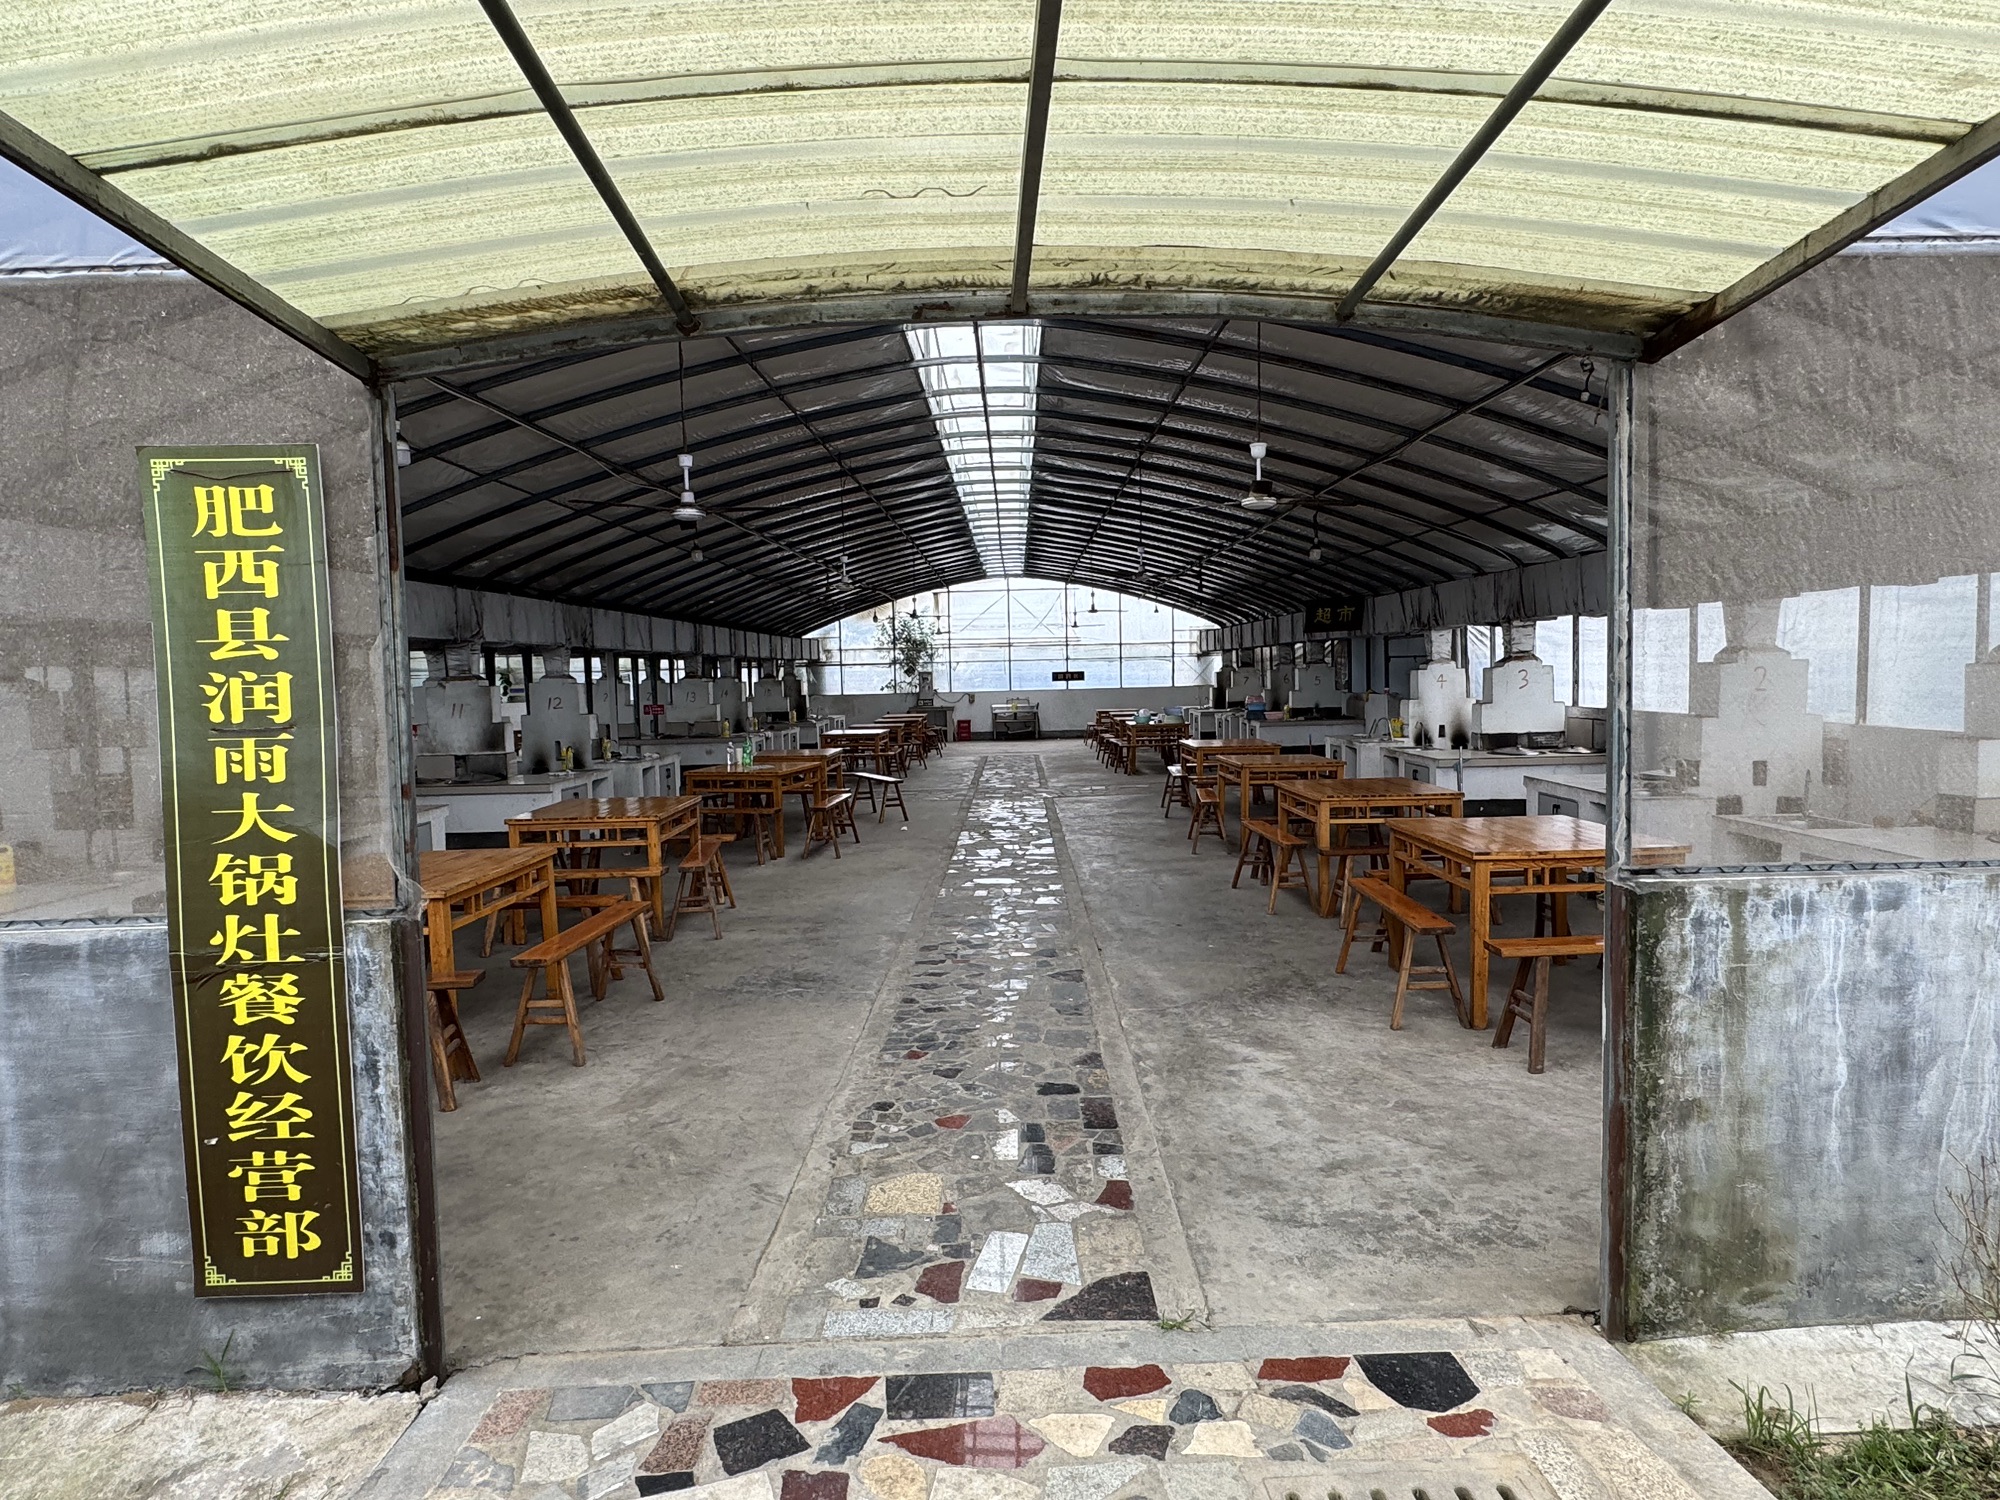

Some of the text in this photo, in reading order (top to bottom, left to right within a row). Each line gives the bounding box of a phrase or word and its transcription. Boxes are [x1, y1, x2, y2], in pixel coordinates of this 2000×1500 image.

[1313, 605, 1356, 624] 超市
[1314, 675, 1321, 686] 5
[1436, 673, 1447, 689] 4
[1518, 669, 1529, 690] 3
[1753, 666, 1767, 691] 2
[547, 696, 564, 711] 12
[685, 691, 697, 703] 13
[450, 703, 464, 719] 11
[192, 484, 322, 1260] 肥西县润雨大锅灶餐饮经营部
